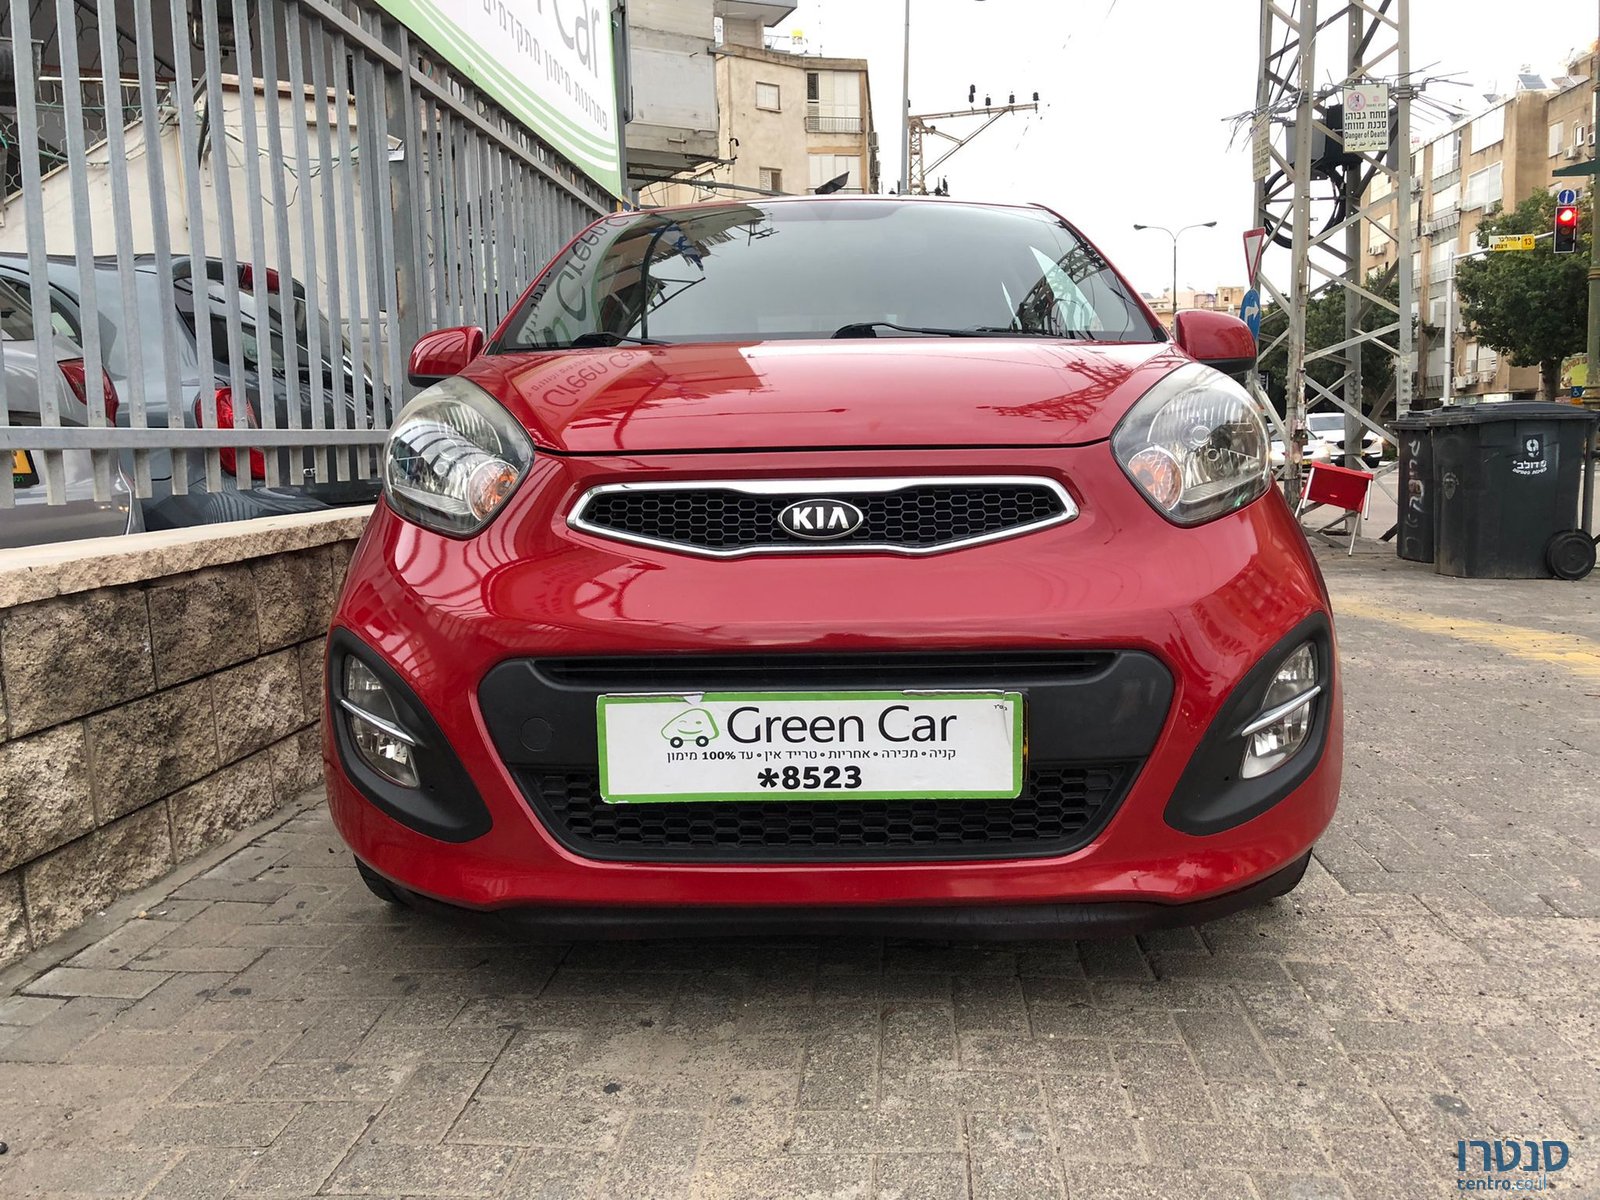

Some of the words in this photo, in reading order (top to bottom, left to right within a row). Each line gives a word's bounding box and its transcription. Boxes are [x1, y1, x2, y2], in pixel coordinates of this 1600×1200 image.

[544, 50, 571, 95] מימון
[574, 81, 608, 131] פתרונות
[1346, 112, 1366, 120] גבוה!
[1370, 111, 1386, 119] מתח
[1367, 121, 1387, 129] סכנת
[1344, 131, 1363, 140] Danger
[1363, 130, 1370, 138] of
[1524, 237, 1532, 246] 13
[1516, 460, 1540, 469] דולב
[792, 506, 850, 529] KIA
[726, 706, 865, 744] Green
[877, 705, 957, 743] Car
[667, 752, 698, 763] מימון
[702, 751, 737, 760] 100%
[738, 751, 754, 760] עד
[764, 751, 782, 762] אין
[785, 750, 818, 759] טרייד
[828, 750, 871, 759] אחריות
[881, 749, 919, 758] מכירה
[929, 749, 956, 760] קניה
